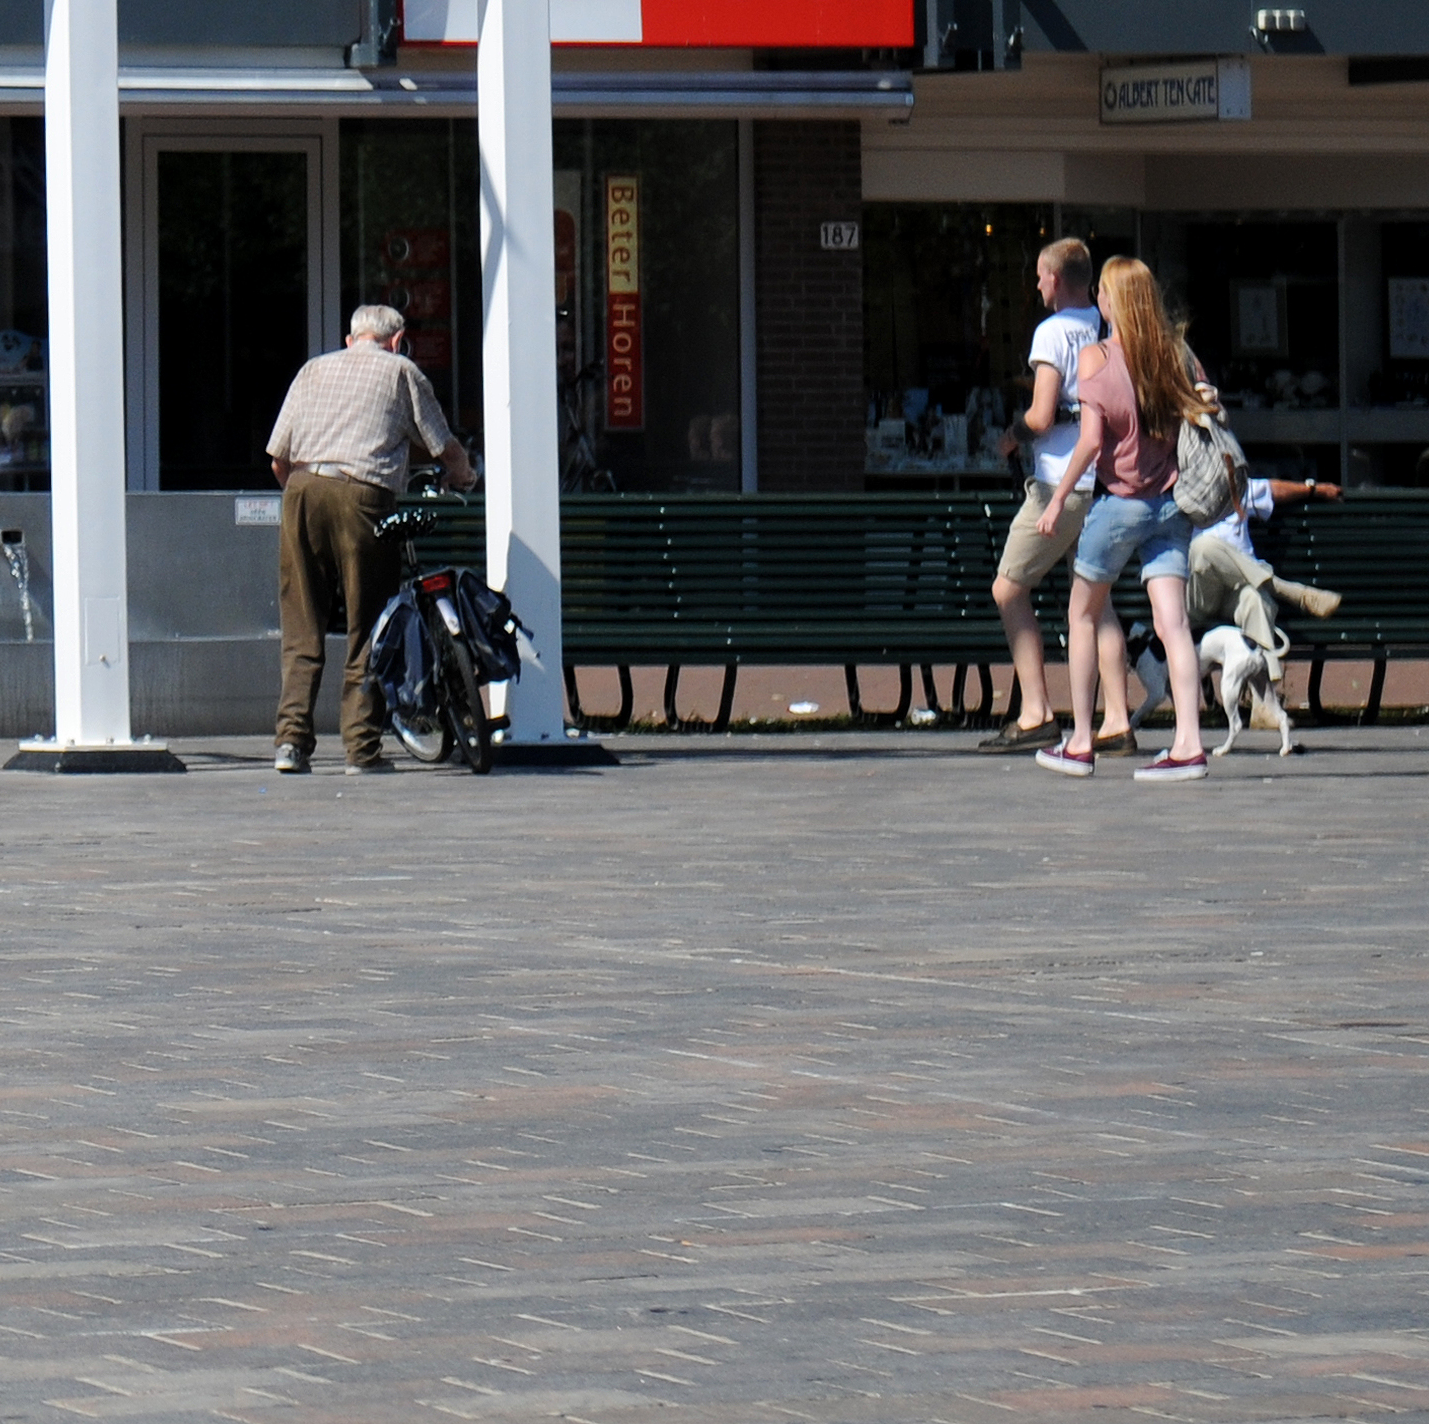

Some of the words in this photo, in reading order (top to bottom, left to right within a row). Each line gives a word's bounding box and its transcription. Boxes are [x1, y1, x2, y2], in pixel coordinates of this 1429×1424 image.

[1119, 81, 1159, 109] ALBERT
[1162, 78, 1184, 107] TEN
[1186, 75, 1215, 105] CATE
[611, 185, 635, 283] Beter
[823, 226, 856, 247] 187
[613, 303, 636, 418] Horen
